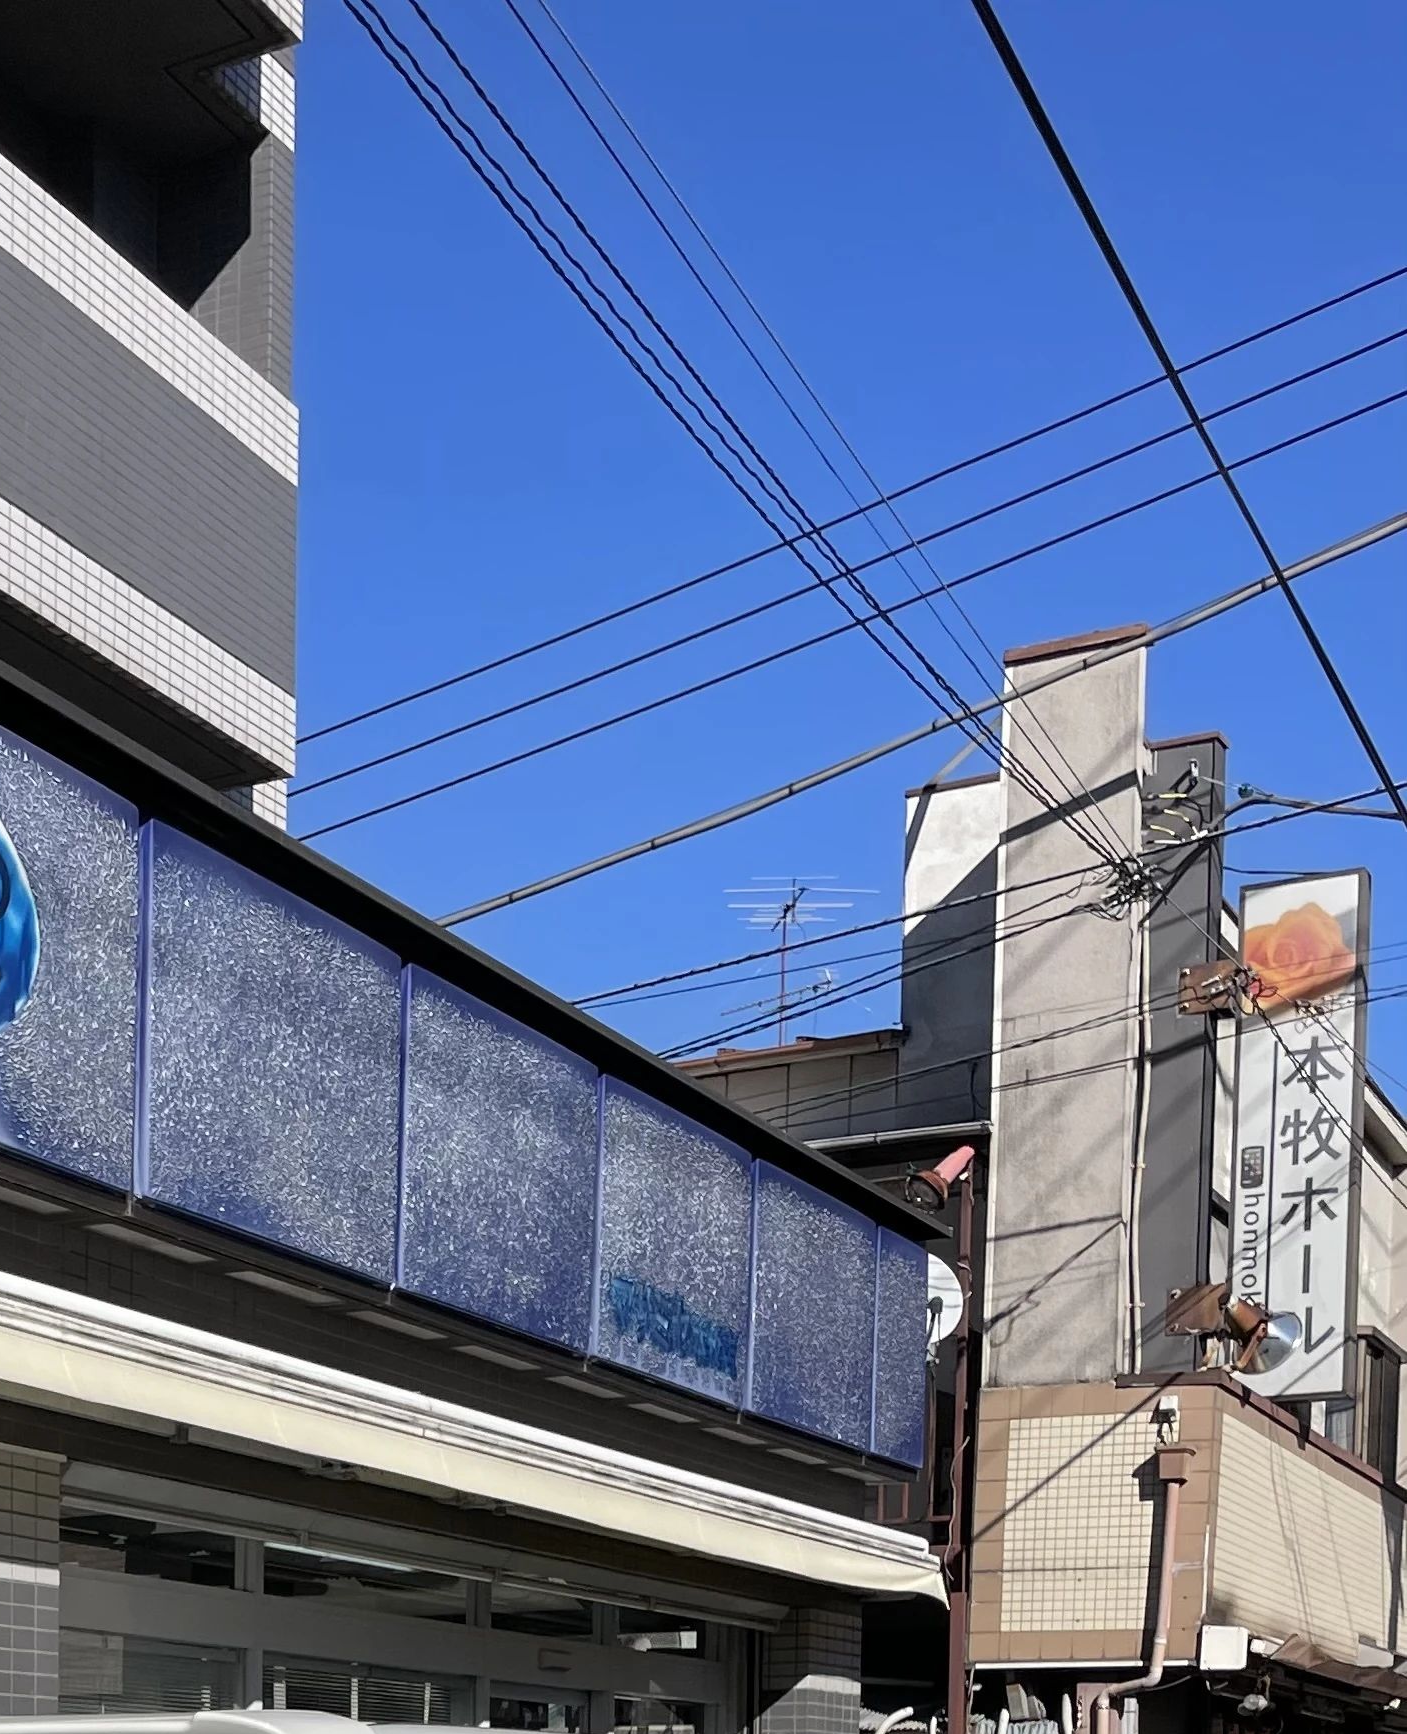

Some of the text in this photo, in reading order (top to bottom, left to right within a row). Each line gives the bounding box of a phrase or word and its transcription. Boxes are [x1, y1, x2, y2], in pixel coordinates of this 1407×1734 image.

[1241, 1192, 1266, 1308] honmok
[1279, 1035, 1347, 1354] 本牧ホール
